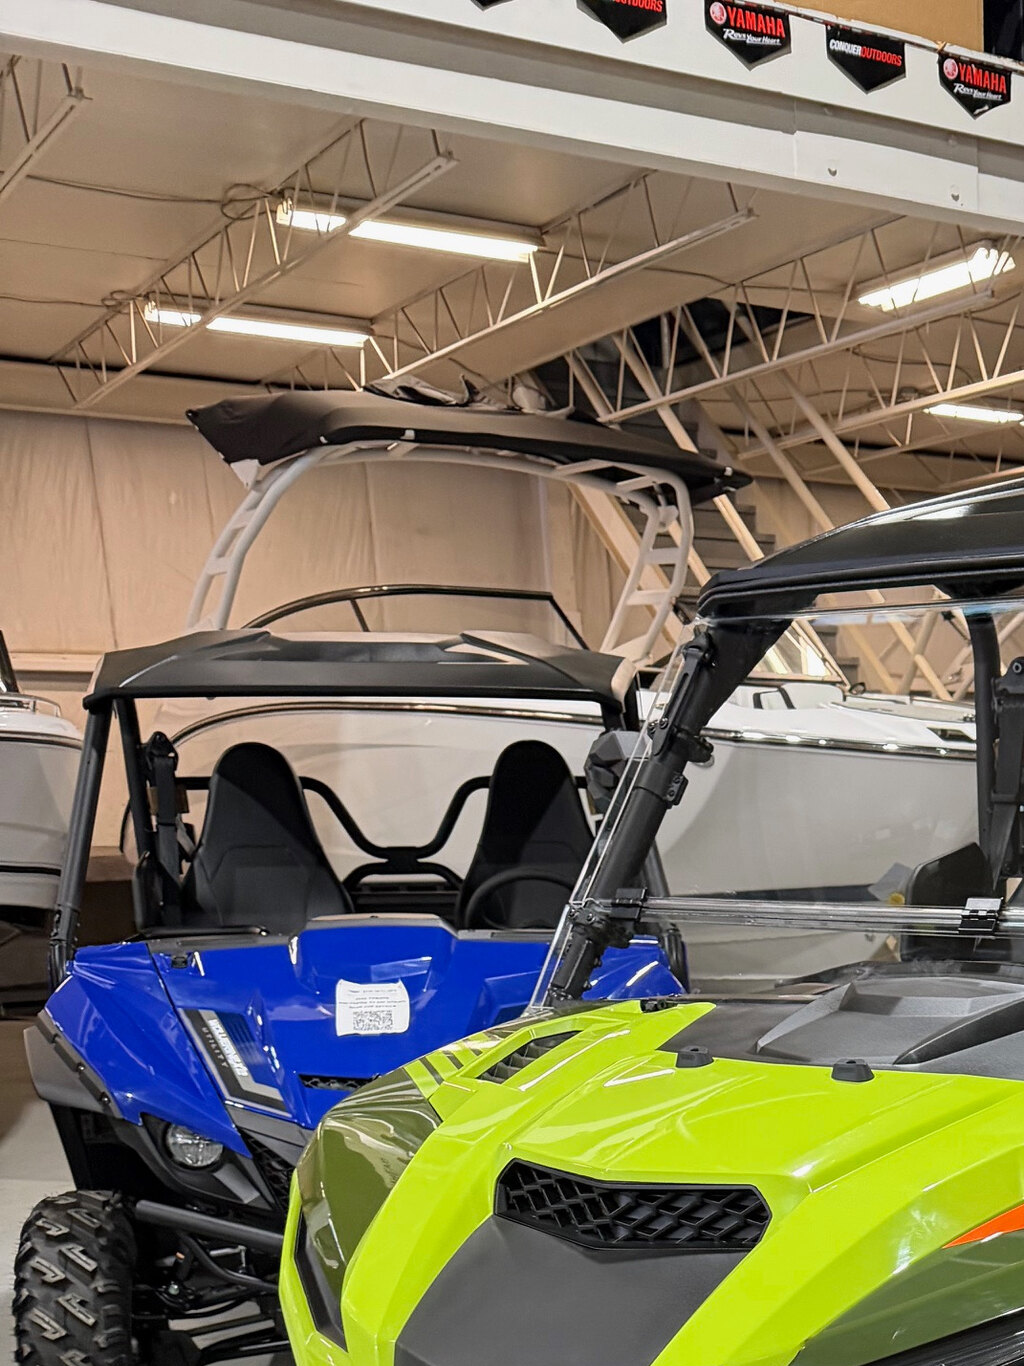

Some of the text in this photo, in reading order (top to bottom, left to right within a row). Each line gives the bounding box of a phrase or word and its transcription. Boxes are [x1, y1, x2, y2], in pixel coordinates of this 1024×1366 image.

[726, 6, 785, 38] YAMAHA
[958, 62, 1006, 95] YAMAHA
[201, 1027, 229, 1068] UTILITY
